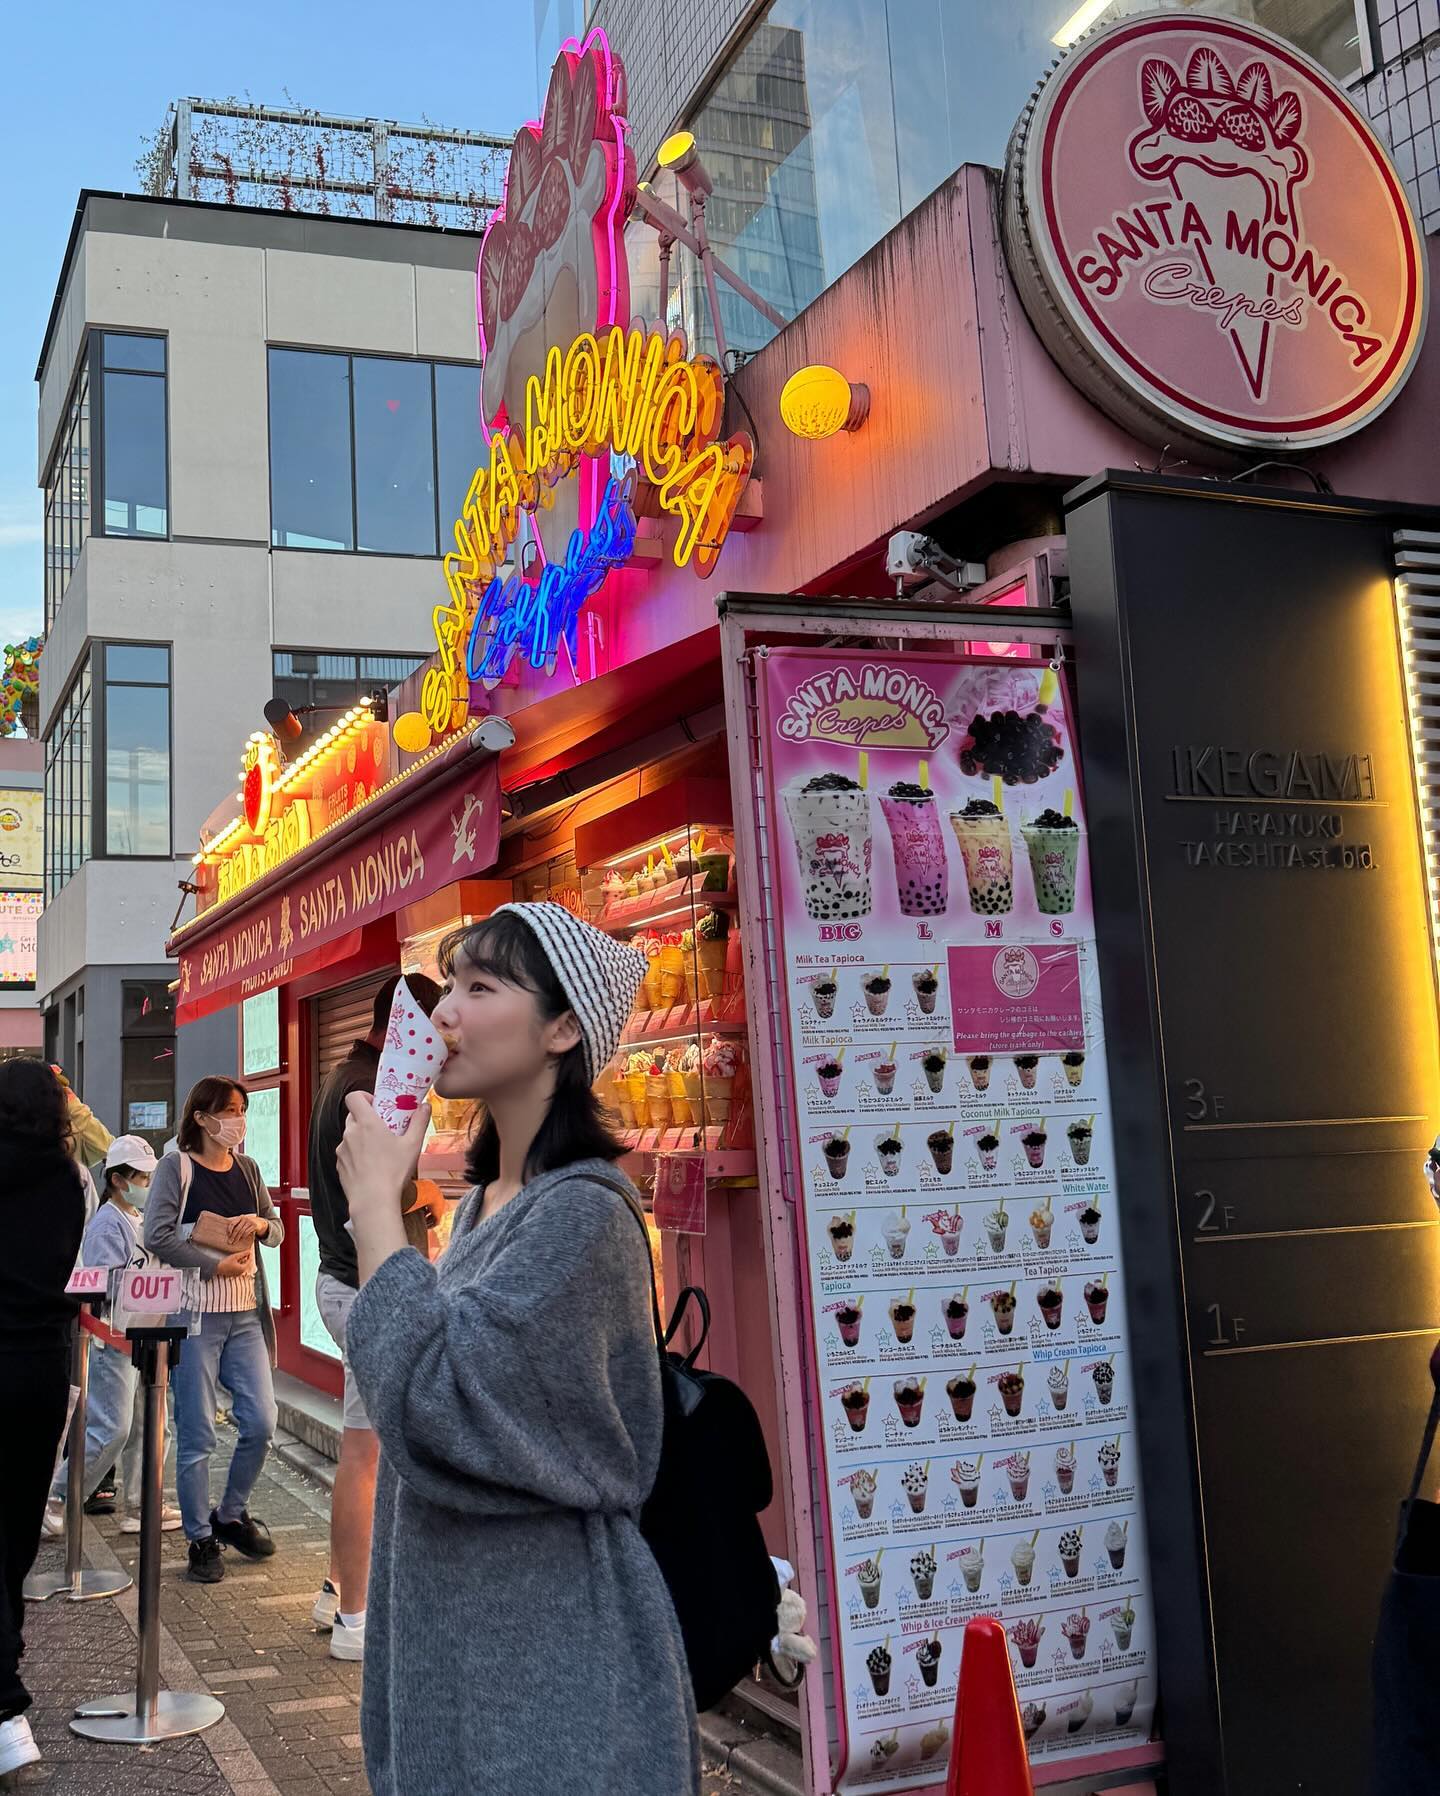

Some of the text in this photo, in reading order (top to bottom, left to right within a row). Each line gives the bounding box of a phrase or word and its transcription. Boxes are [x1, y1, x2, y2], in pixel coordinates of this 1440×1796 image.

[1077, 200, 1383, 367] SANTA MONICA
[1143, 262, 1304, 330] Crepes
[421, 324, 732, 732] SANTA MONICA
[782, 669, 948, 746] SANTA MONICA
[816, 709, 905, 743] Crepes
[1174, 745, 1376, 800] IKEGAMI
[1178, 841, 1304, 867] TAKESHITA
[299, 830, 425, 939] SANTA MONICA
[818, 924, 862, 942] BIG
[917, 923, 933, 939] L
[985, 920, 1003, 938] M
[1050, 921, 1064, 937] S
[200, 916, 273, 986] SANTA MONICA
[795, 954, 865, 964] Milk Tea Tapioca
[802, 1035, 853, 1045] Milk Tapioca
[956, 1032, 979, 1040] Please
[980, 1031, 998, 1040] bring
[1011, 1031, 1037, 1039] garbage
[1183, 1078, 1225, 1120] 3F
[961, 1107, 1040, 1119] Coconut Milk Tapioca
[1063, 1182, 1110, 1192] White Water
[1194, 1189, 1238, 1231] 2F
[71, 1271, 100, 1288] IN
[1024, 1265, 1068, 1277] Tea Tapioca
[131, 1275, 174, 1300] OUT
[820, 1281, 851, 1292] Tapioca
[1207, 1303, 1246, 1345] 1F
[1033, 1345, 1107, 1360] Whip Cream Tapioca
[901, 1621, 923, 1633] Whip
[923, 1619, 931, 1628] &
[931, 1617, 944, 1628] Ice
[944, 1614, 971, 1626] Cream
